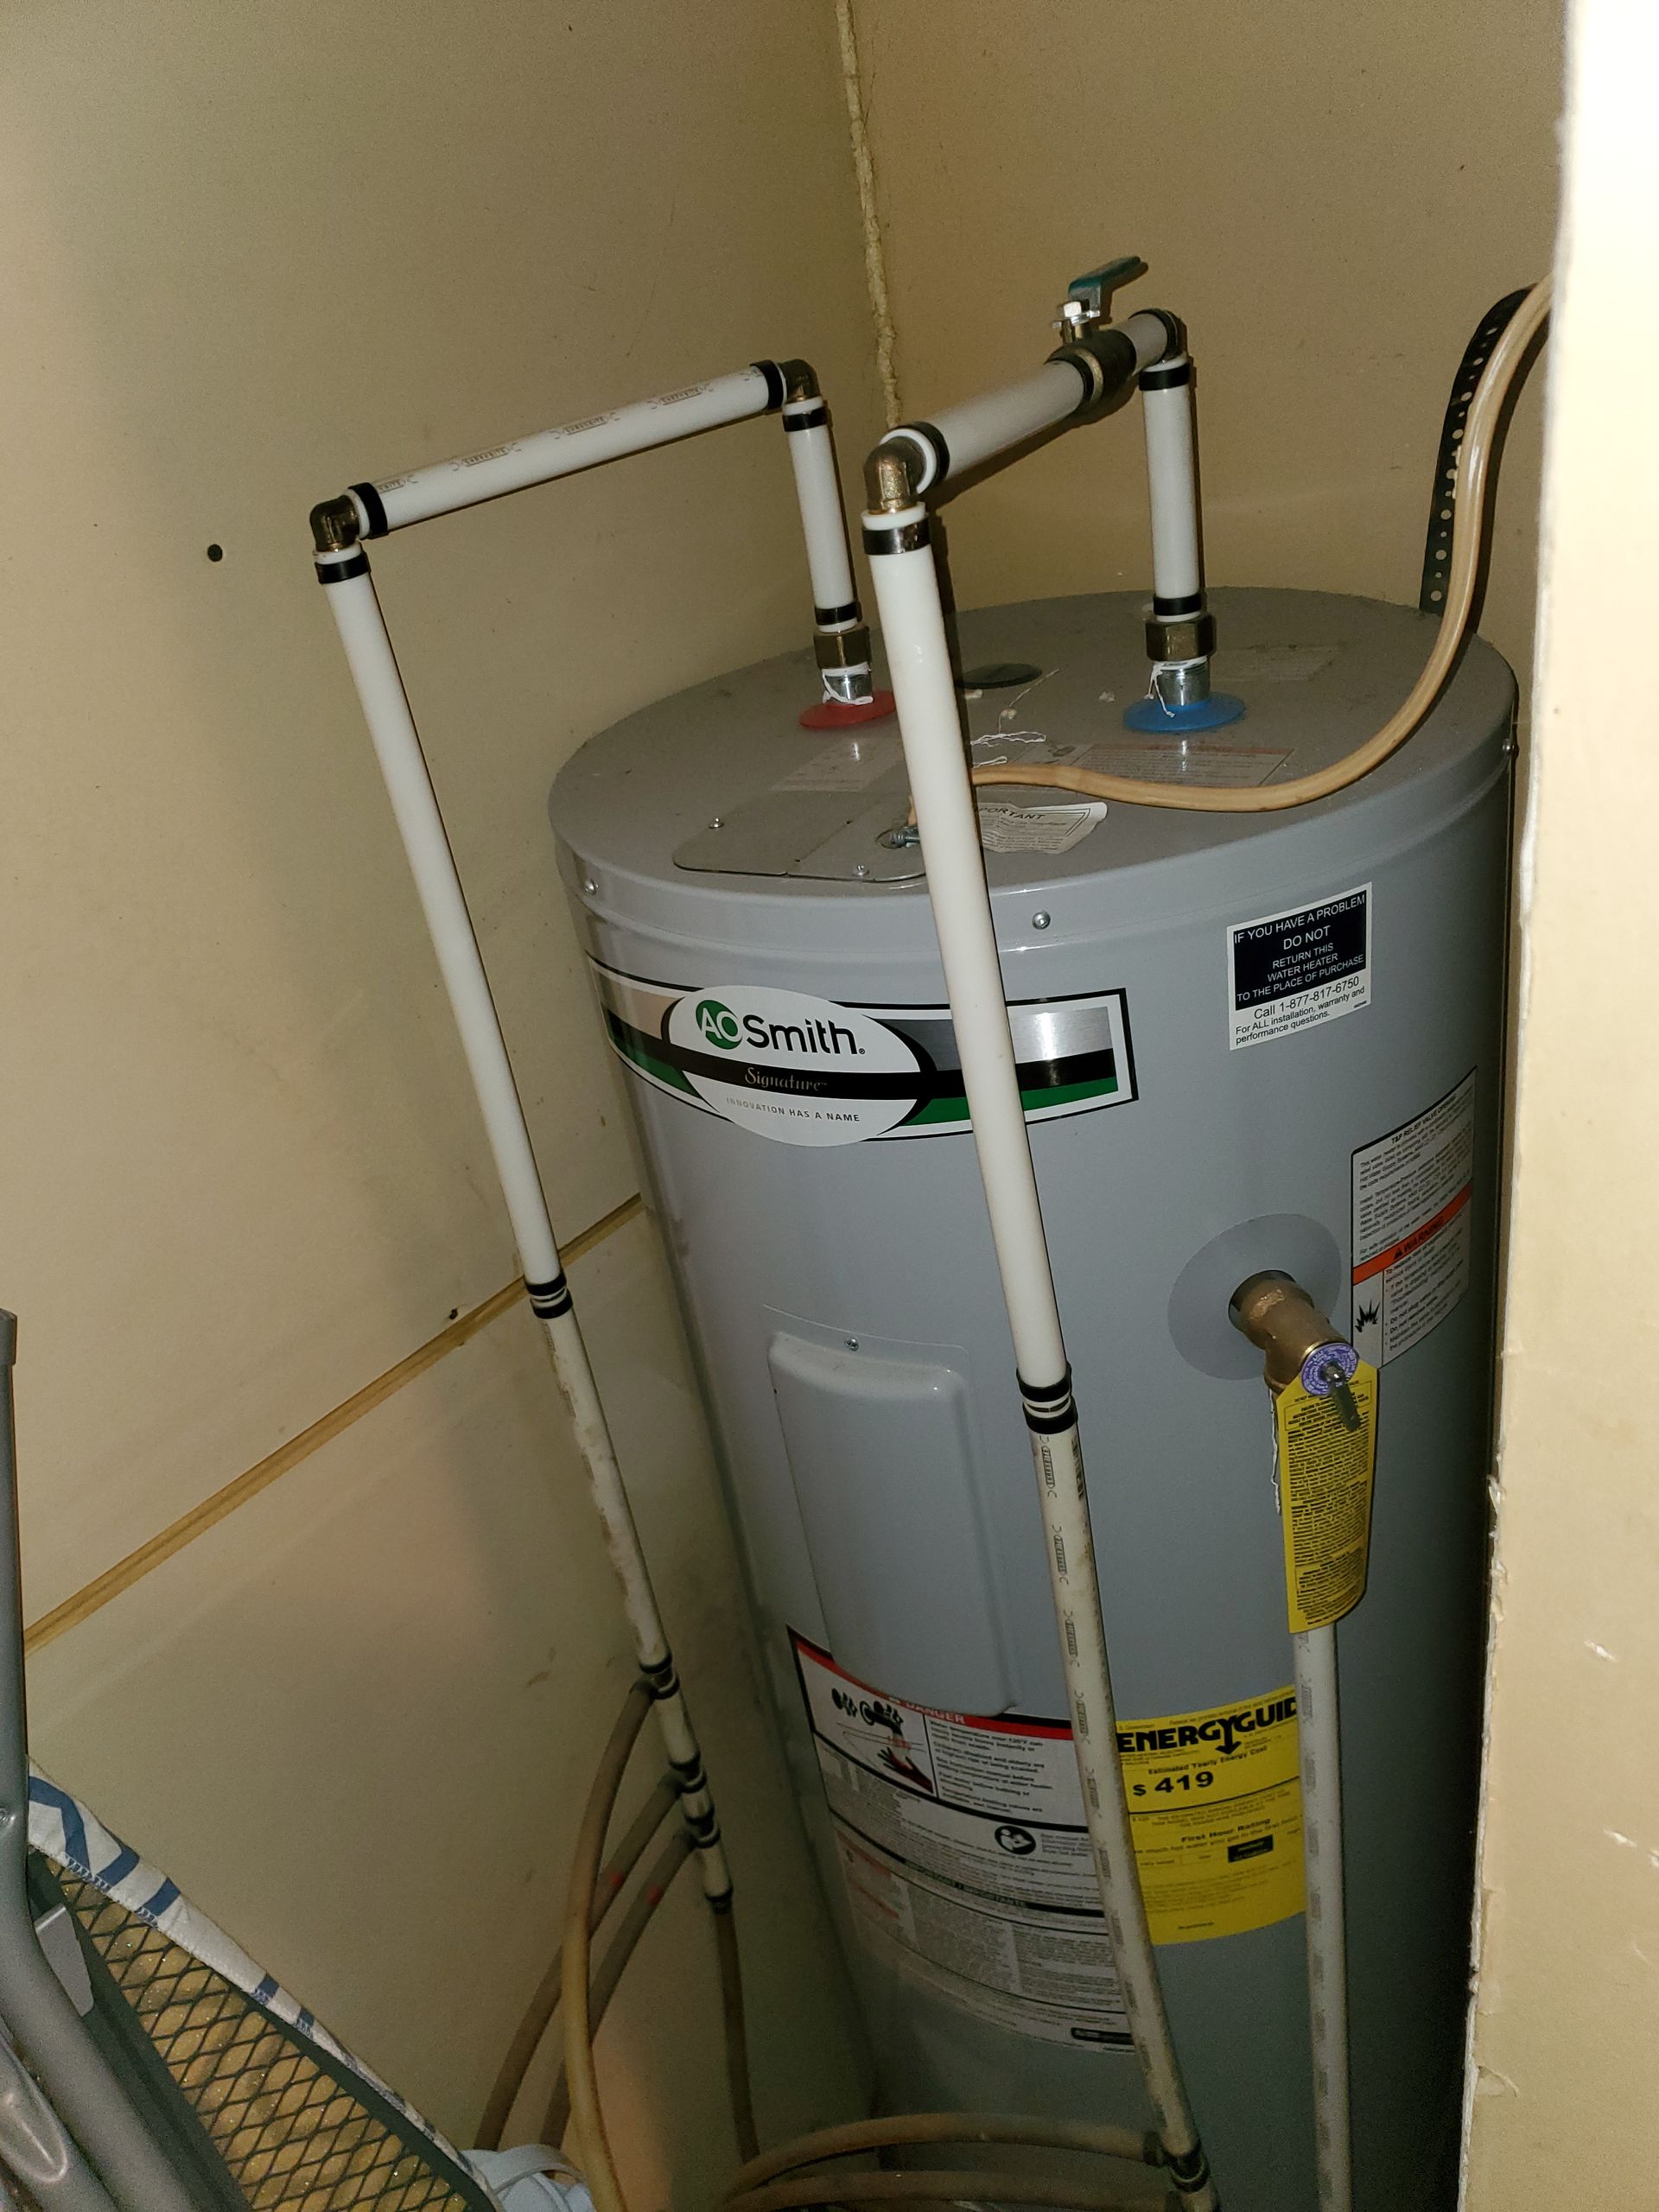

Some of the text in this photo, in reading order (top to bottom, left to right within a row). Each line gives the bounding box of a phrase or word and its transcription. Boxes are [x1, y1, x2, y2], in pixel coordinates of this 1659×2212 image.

[979, 808, 1046, 821] PORTANT
[1234, 894, 1365, 944] IF YOU HAVE A PROBLEM
[1283, 925, 1331, 950] DO NOT
[1268, 953, 1338, 982] WATER HEATER
[1273, 943, 1333, 969] RETURN THIS
[1237, 954, 1364, 1002] TO THE PLACE OF PURCHASE
[1236, 1026, 1251, 1034] For
[1253, 1020, 1269, 1031] ALL
[1318, 993, 1350, 1012] warranty
[1351, 986, 1364, 998] and
[1255, 976, 1359, 1020] Call 1-877-817-6750
[697, 1002, 858, 1055] AO Smith
[1236, 1011, 1330, 1045] performance questions.
[745, 1067, 822, 1092] Signature
[726, 1096, 861, 1122] INNOVATION HAS A NAME
[1116, 1697, 1296, 1752] ENERGYGUID
[1148, 1745, 1268, 1775] Estimated Yearly Energy Cost
[1132, 1770, 1214, 1796] $ 419
[1237, 1819, 1270, 1831] Rating
